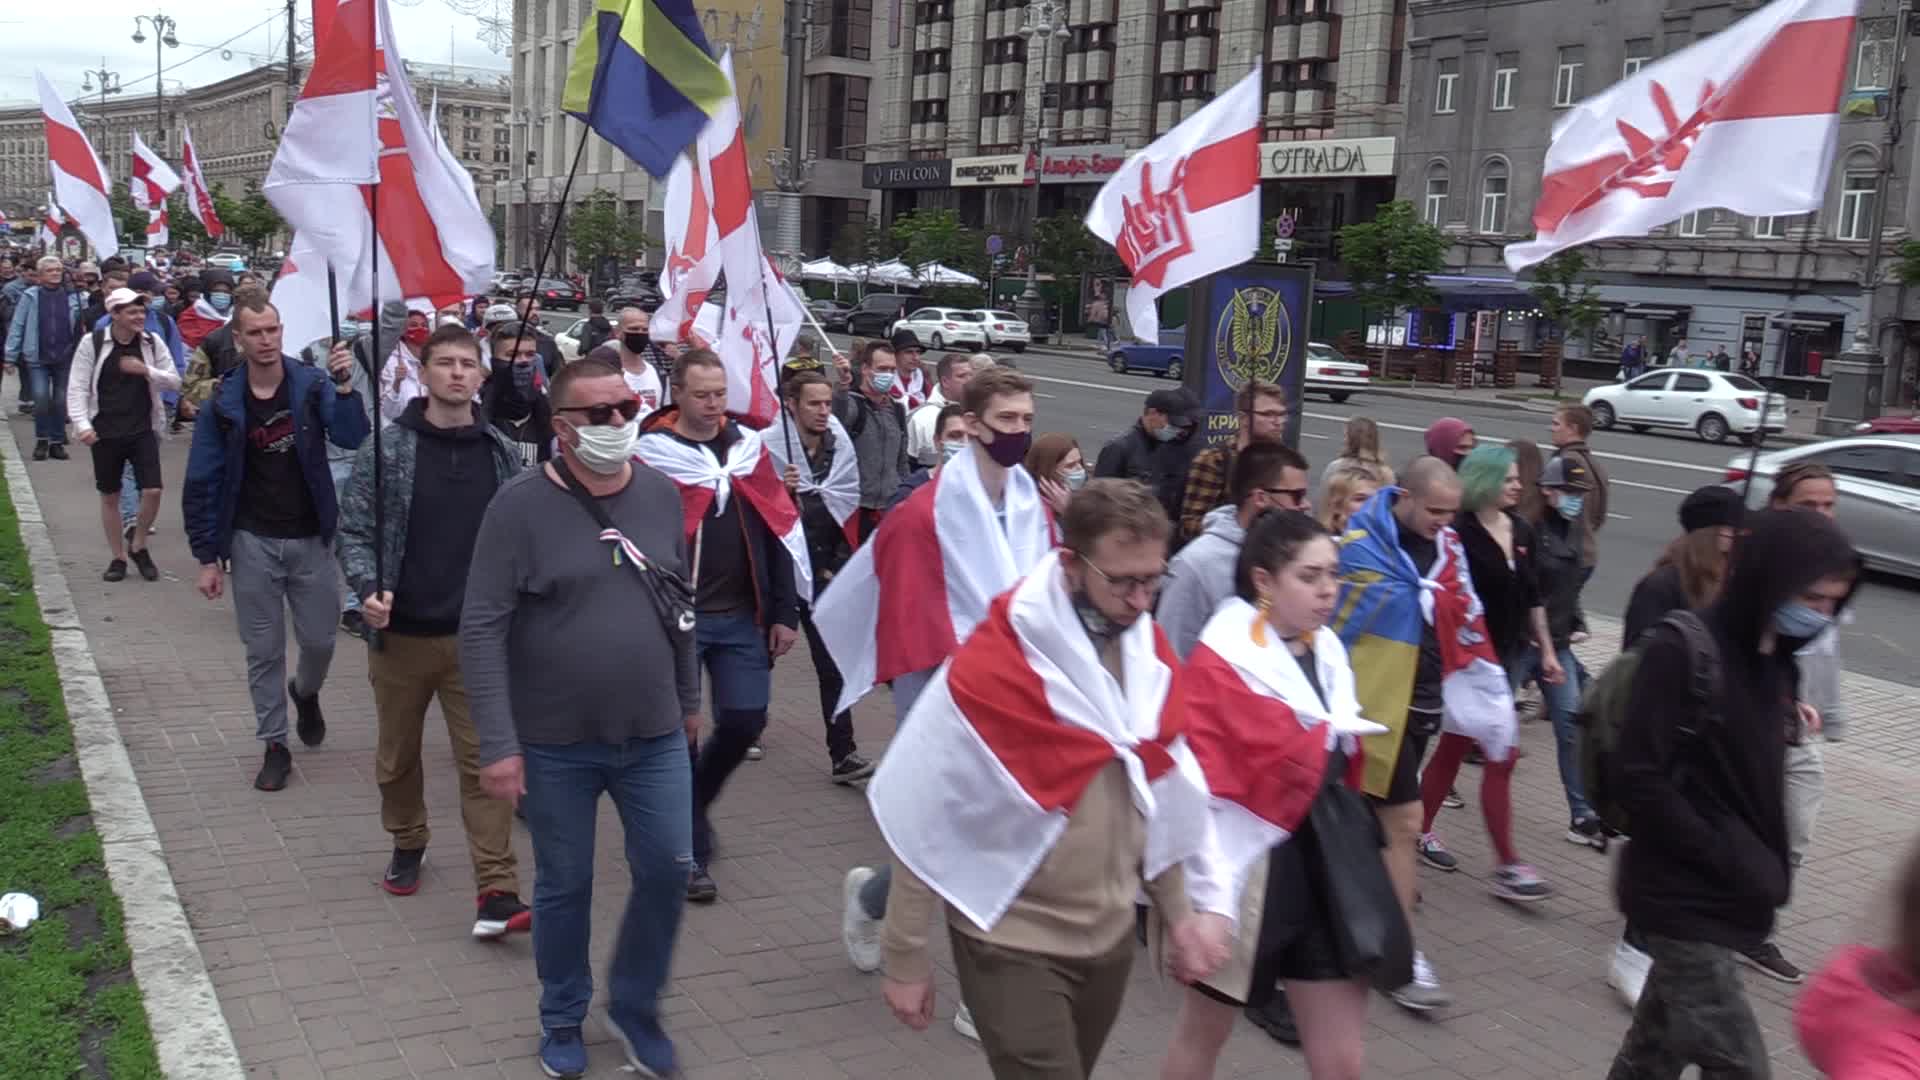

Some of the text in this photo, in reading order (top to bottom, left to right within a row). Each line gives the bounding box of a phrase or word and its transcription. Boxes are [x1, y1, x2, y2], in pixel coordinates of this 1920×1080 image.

[1042, 153, 1124, 177] Альфа-Бан
[1271, 145, 1367, 174] OTRADA
[1208, 414, 1240, 430] КРИ
